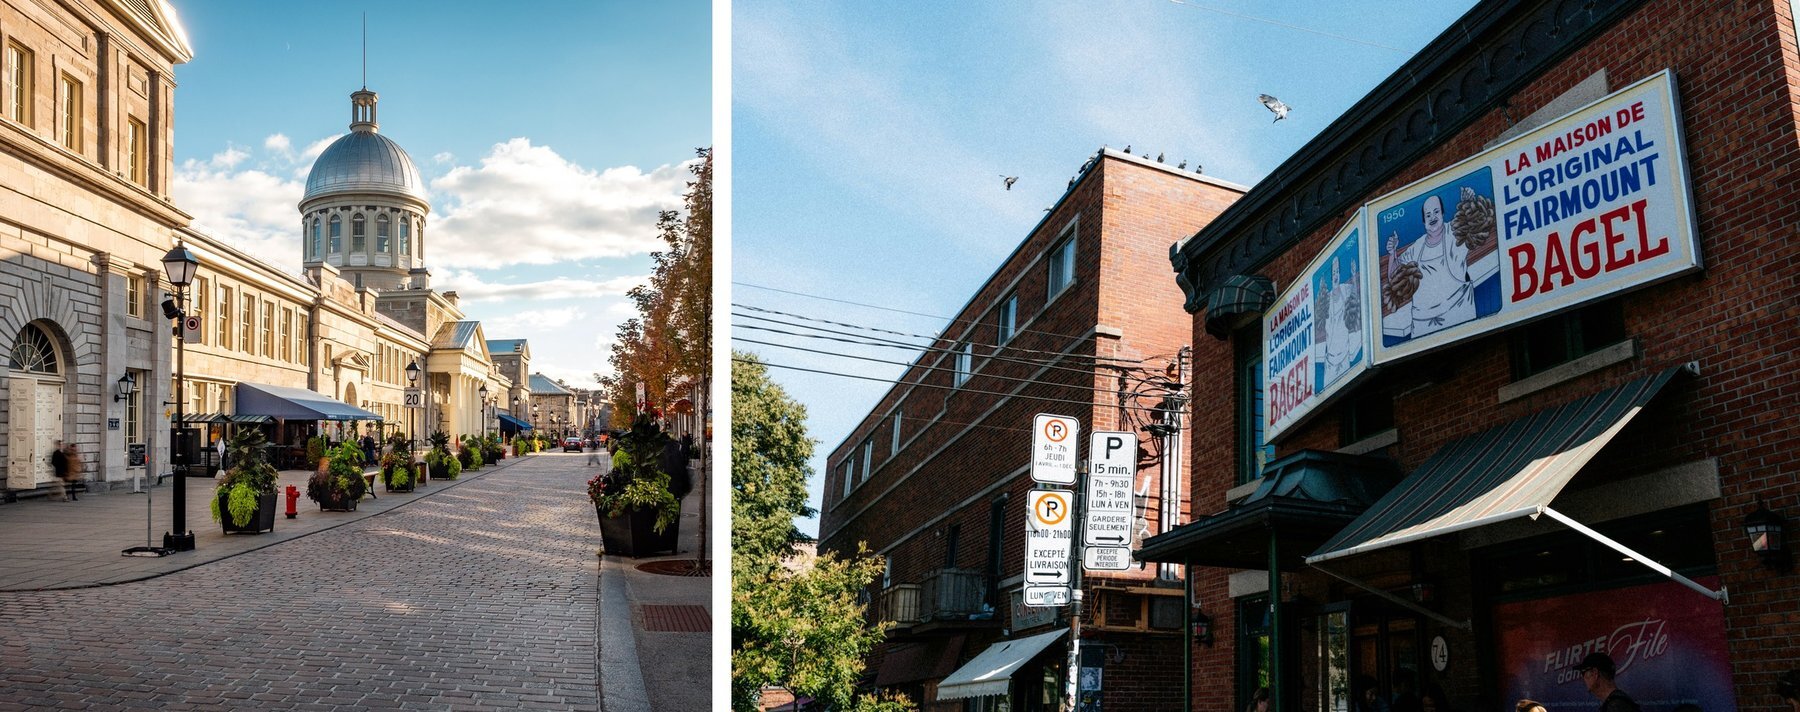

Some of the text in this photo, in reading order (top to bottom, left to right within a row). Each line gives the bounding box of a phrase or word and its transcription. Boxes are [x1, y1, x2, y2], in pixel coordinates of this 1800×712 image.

[1505, 101, 1646, 177] LA MAISON DE
[1503, 130, 1655, 206] L'ORIGINAL
[1503, 153, 1659, 240] FAIRMOUNT
[1383, 207, 1405, 224] 1950
[1507, 198, 1670, 303] BAGEL
[1270, 283, 1310, 333] LA MAISON DE
[1269, 304, 1312, 354] L'ORIGINAL
[1268, 322, 1313, 380] FAIRMOUNT
[1269, 355, 1313, 427] BAGEL
[406, 393, 419, 405] 20
[1043, 443, 1053, 451] 6h
[1058, 445, 1067, 453] 7h
[1106, 436, 1123, 459] P
[1045, 453, 1065, 462] JEUDI
[1094, 463, 1131, 475] 15 min.
[1110, 480, 1129, 489] 9h30
[1096, 490, 1107, 498] 15h
[1114, 491, 1126, 499] 18h
[1091, 498, 1129, 509] LUN À VEN
[1092, 515, 1127, 524] GARDERIE
[1052, 529, 1072, 539] 21h00
[1089, 523, 1129, 532] SEULEMENT
[1033, 547, 1065, 559] EXCEPTÉ
[1029, 560, 1069, 570] LIVRAISON
[1030, 591, 1044, 600] LUN
[1544, 617, 1669, 675] FLIRTE File
[1432, 643, 1447, 664] 74
[1557, 667, 1585, 685] dan
